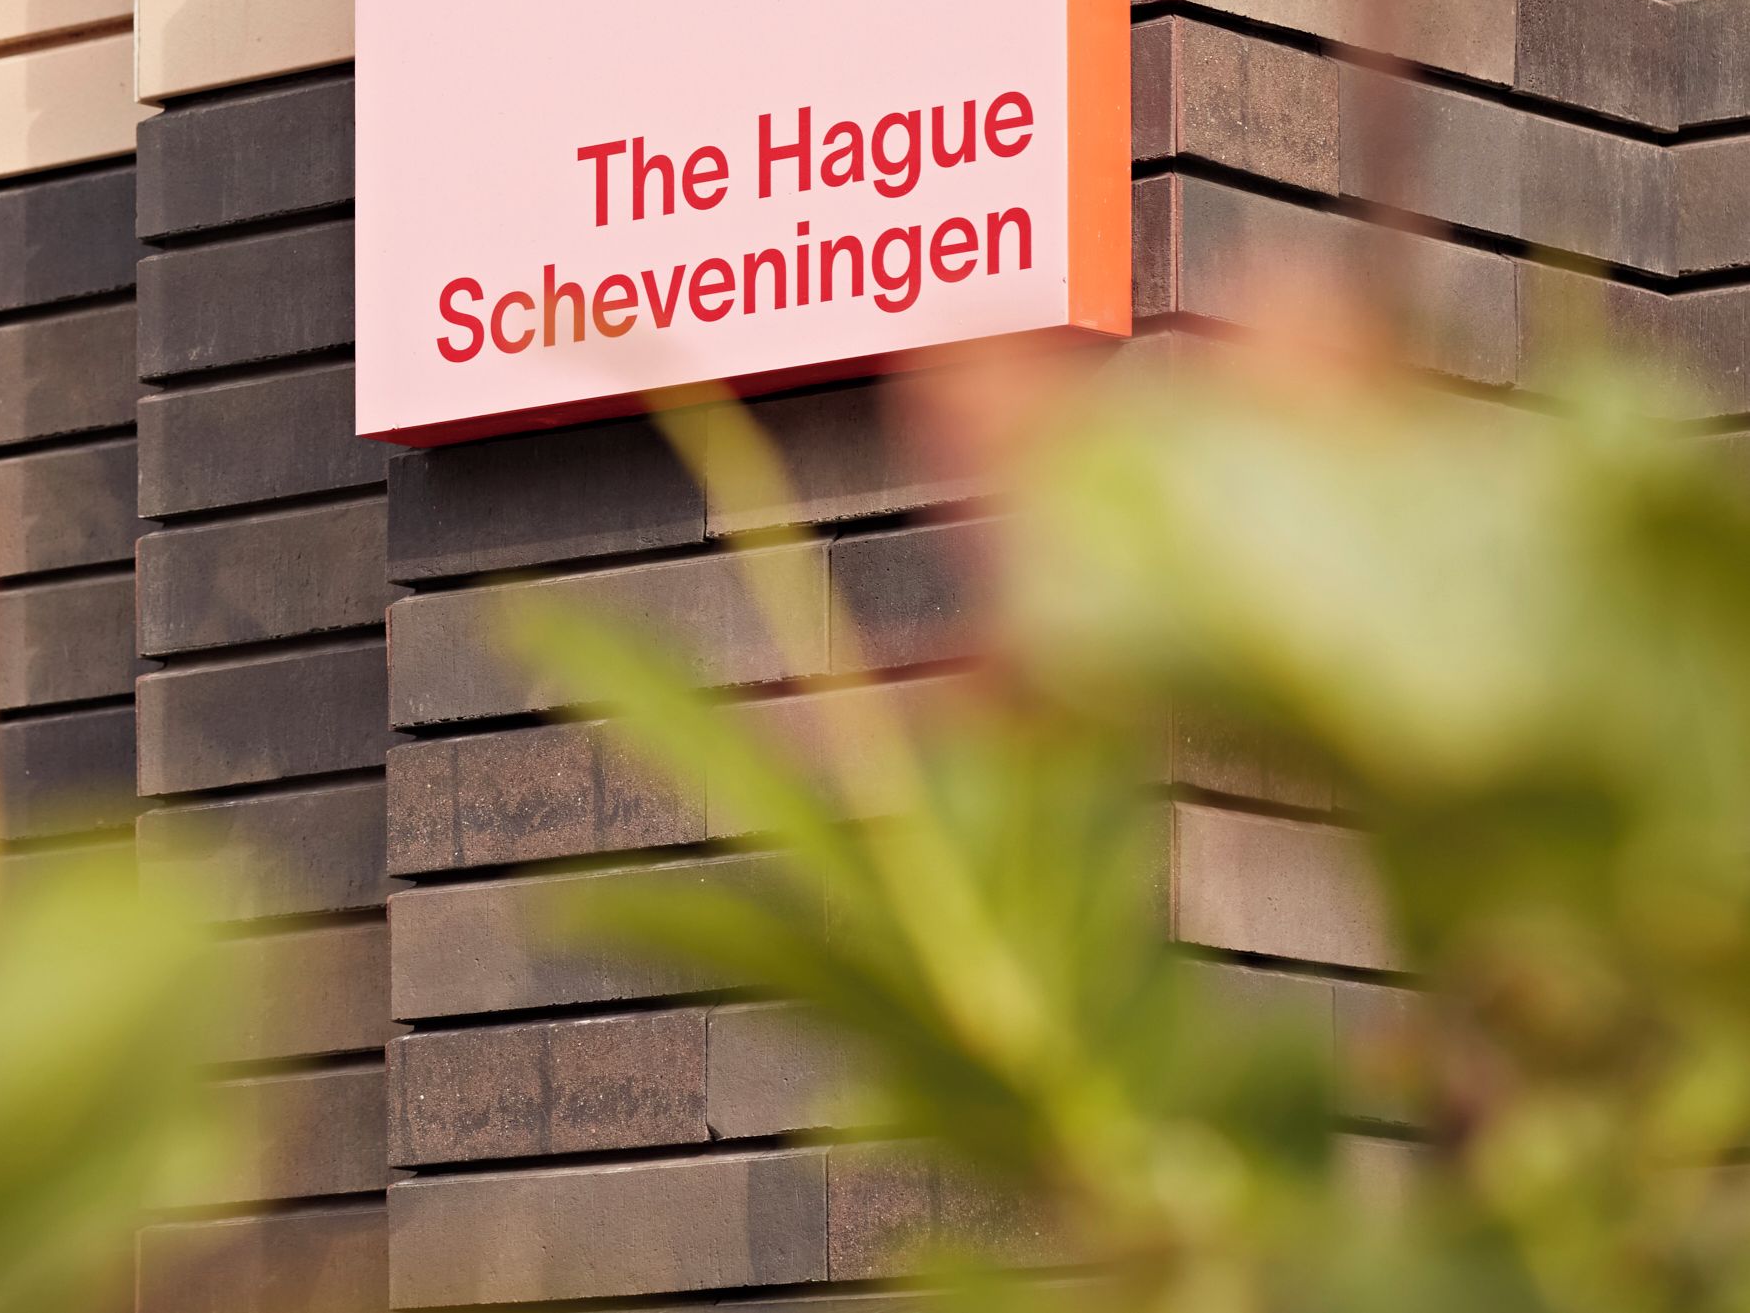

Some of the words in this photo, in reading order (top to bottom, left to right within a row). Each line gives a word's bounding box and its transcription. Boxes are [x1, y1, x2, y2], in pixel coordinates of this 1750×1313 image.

[577, 136, 730, 227] The
[758, 91, 1034, 199] Hague
[436, 206, 1033, 364] Scheveningen
